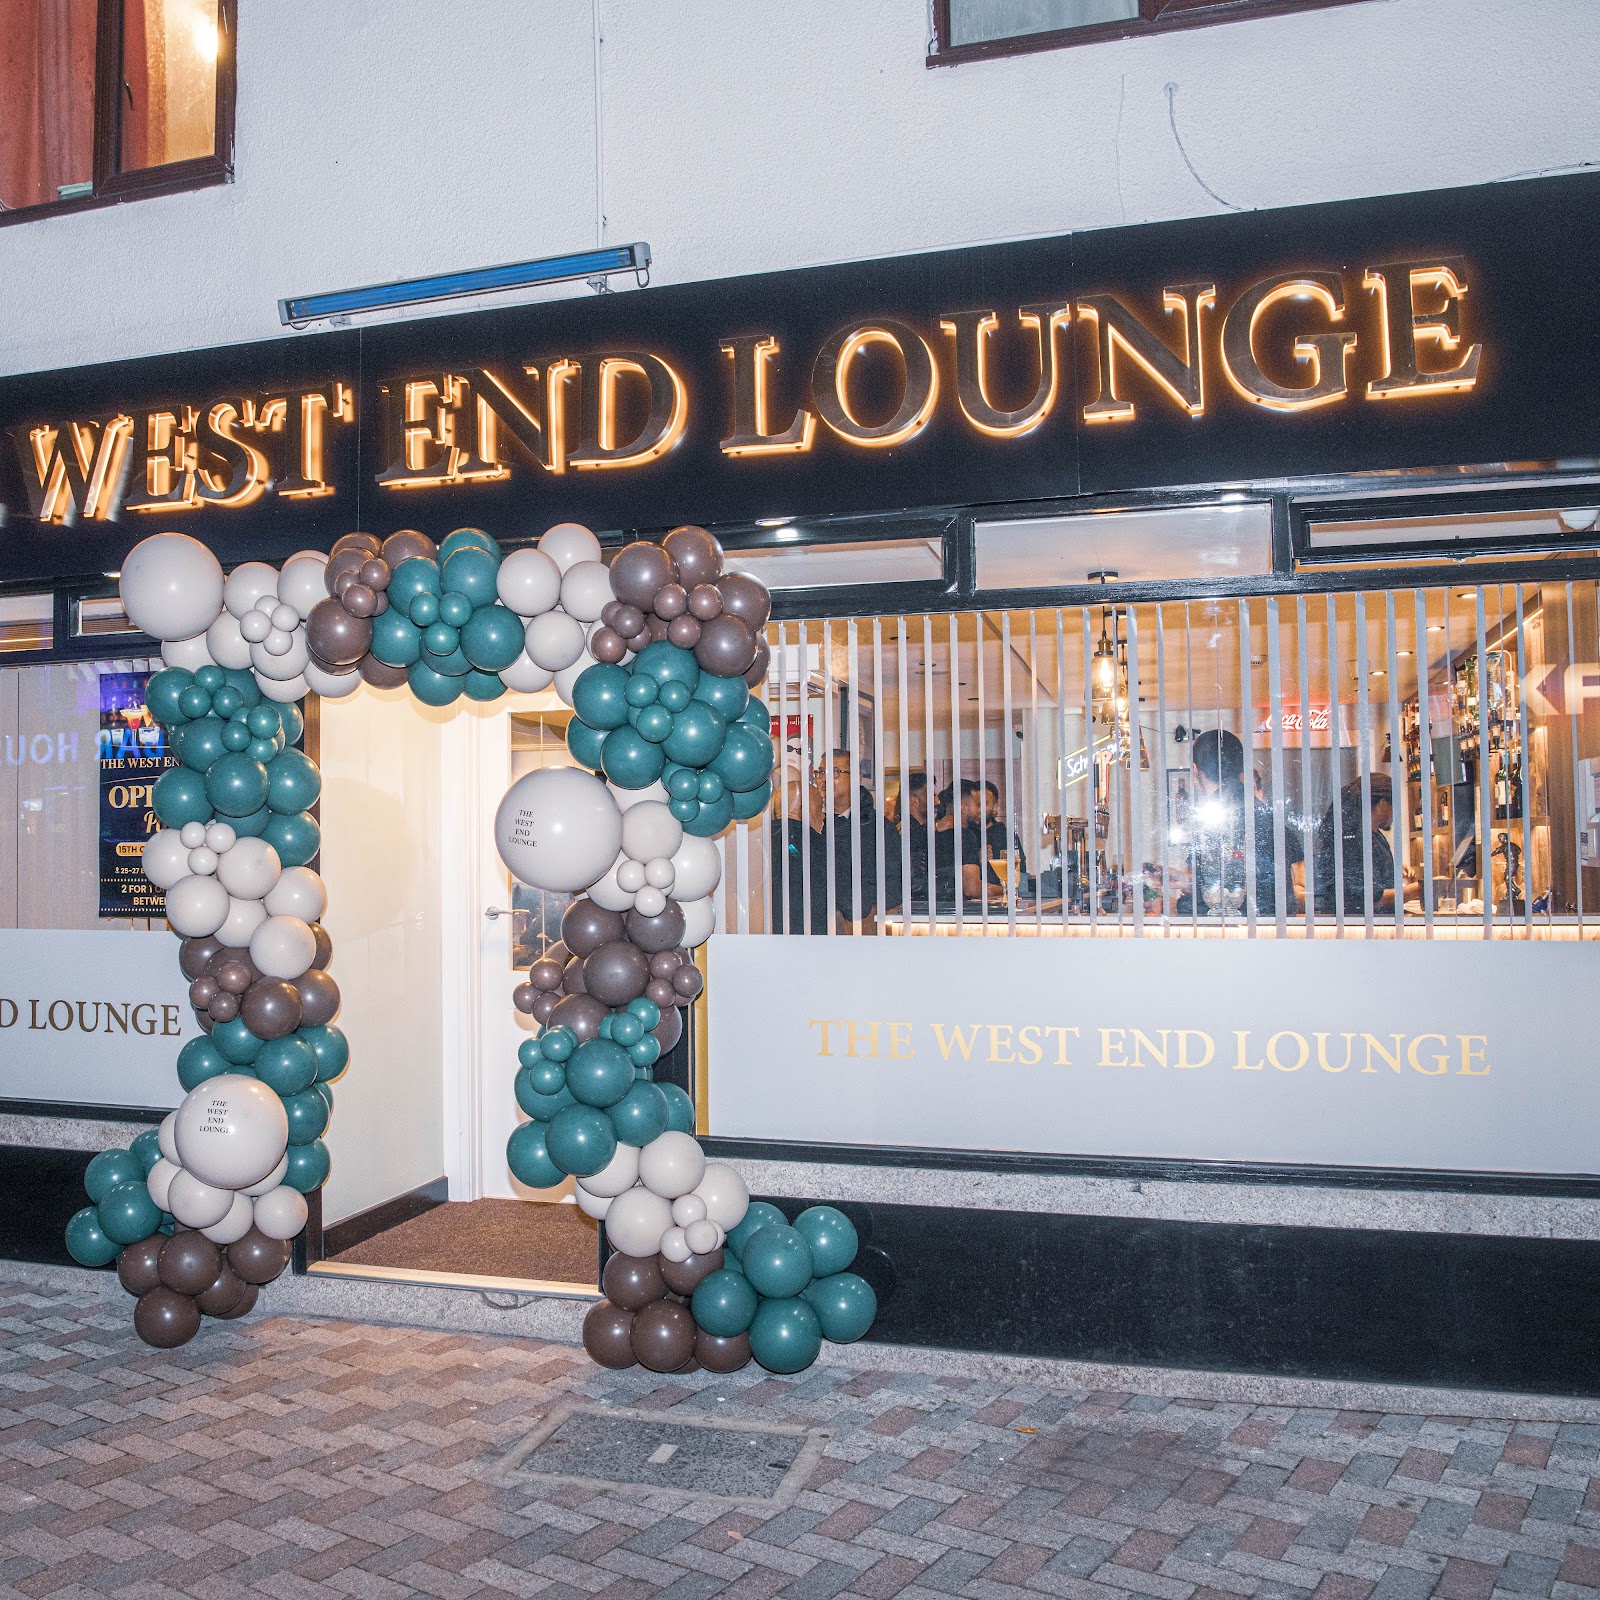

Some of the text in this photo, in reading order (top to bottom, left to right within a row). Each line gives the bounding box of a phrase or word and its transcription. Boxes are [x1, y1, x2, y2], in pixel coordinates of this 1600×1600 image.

[6, 255, 1482, 520] WEST END LOUNGE
[100, 758, 125, 770] THE
[127, 757, 161, 769] WEST
[519, 809, 534, 818] THE
[514, 818, 535, 828] WEST
[515, 828, 531, 837] END
[508, 836, 538, 848] LOUNGE
[118, 845, 138, 854] 15TH
[121, 884, 127, 893] 2
[128, 884, 147, 893] FOR
[28, 999, 182, 1037] LOUNGE
[808, 1017, 1492, 1077] THE WEST END LOUNGE
[207, 1108, 229, 1116] WEST
